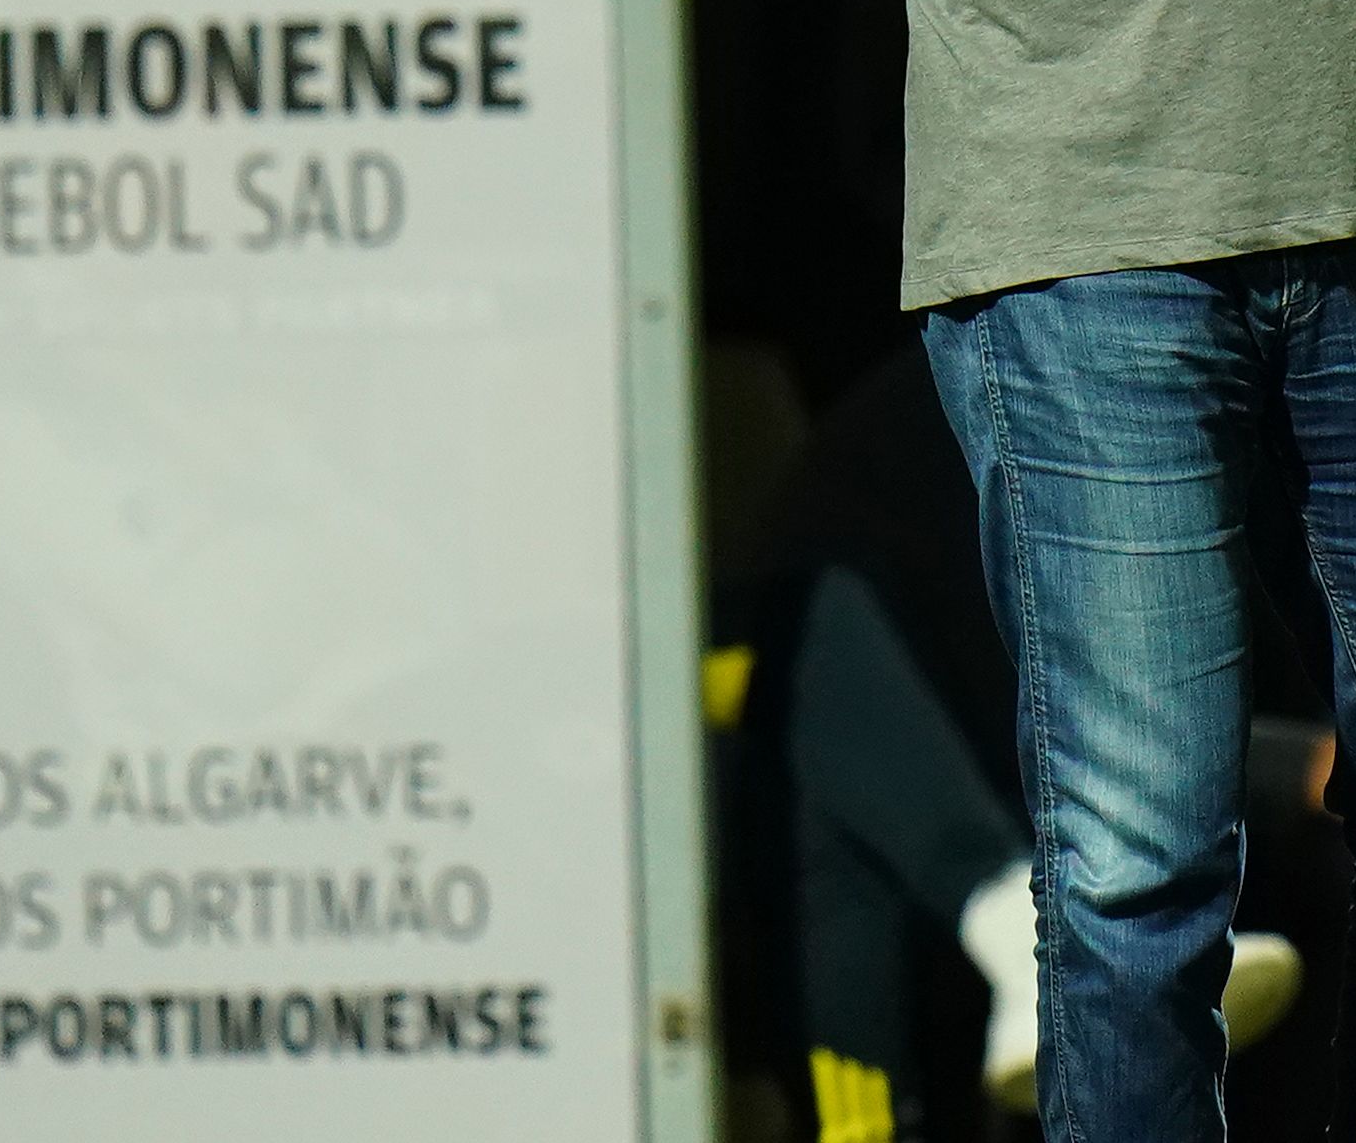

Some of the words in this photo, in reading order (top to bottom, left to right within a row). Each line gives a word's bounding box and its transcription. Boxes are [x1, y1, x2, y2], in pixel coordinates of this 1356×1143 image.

[235, 152, 406, 252] SAD
[92, 742, 472, 828] ALGARVE,
[82, 845, 492, 949] PORTIMÃO
